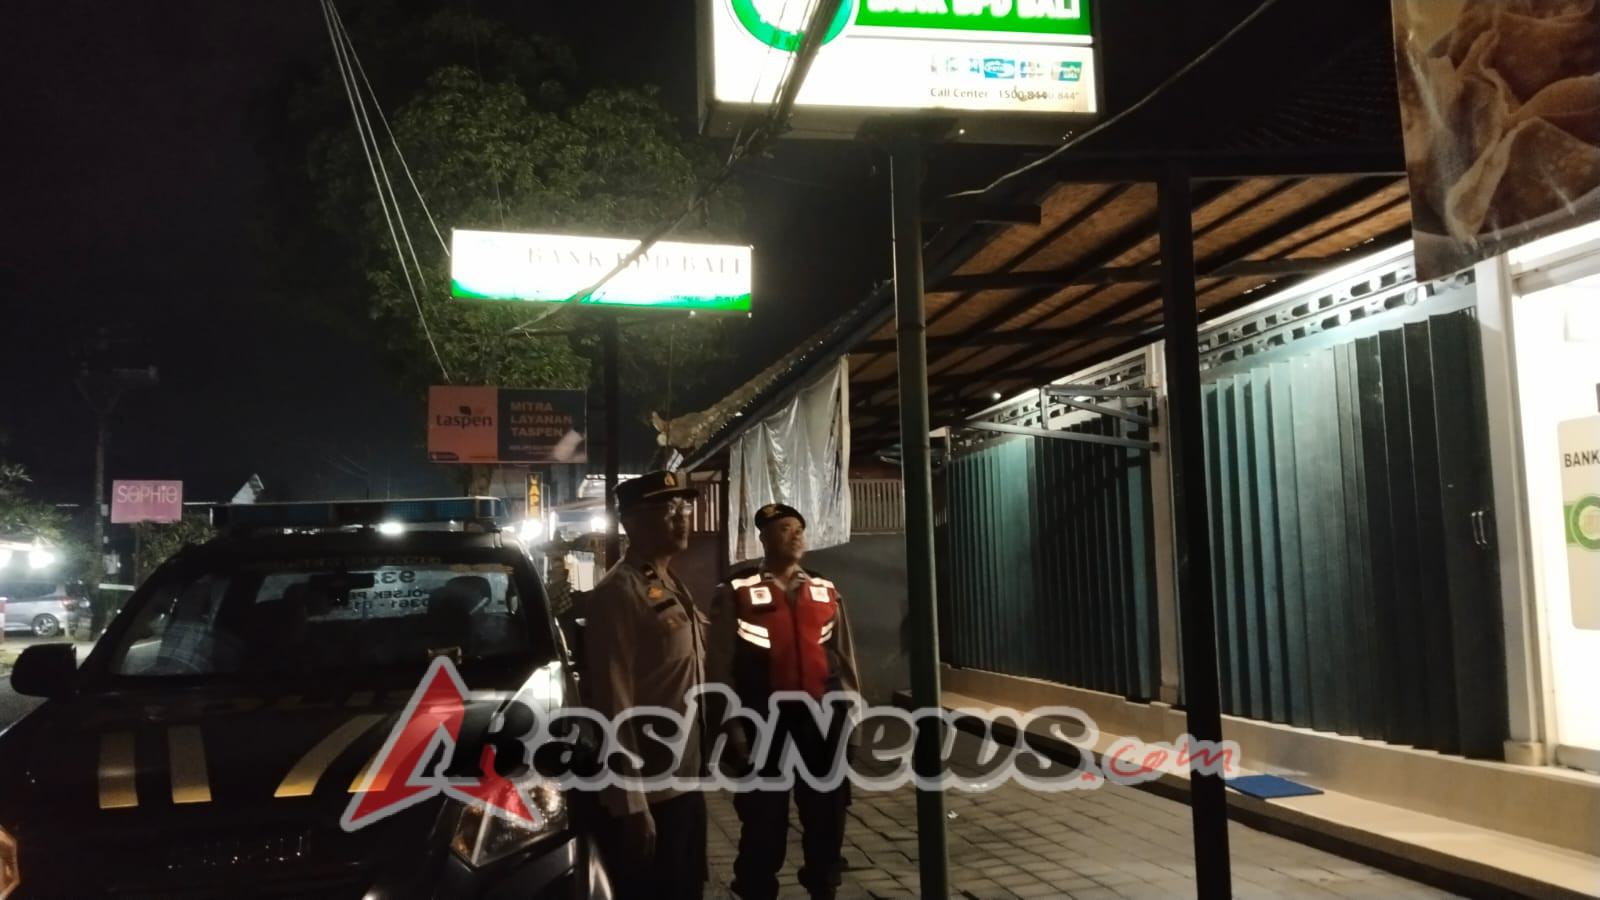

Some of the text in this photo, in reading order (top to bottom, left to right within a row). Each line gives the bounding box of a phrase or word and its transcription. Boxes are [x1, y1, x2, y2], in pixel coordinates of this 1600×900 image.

[930, 87, 950, 98] Call
[953, 88, 988, 99] Center
[510, 401, 553, 412] MITRA
[435, 413, 493, 430] taspen
[510, 414, 573, 425] LAYANAN
[511, 427, 563, 437] TASPEN
[1564, 450, 1600, 468] BANK
